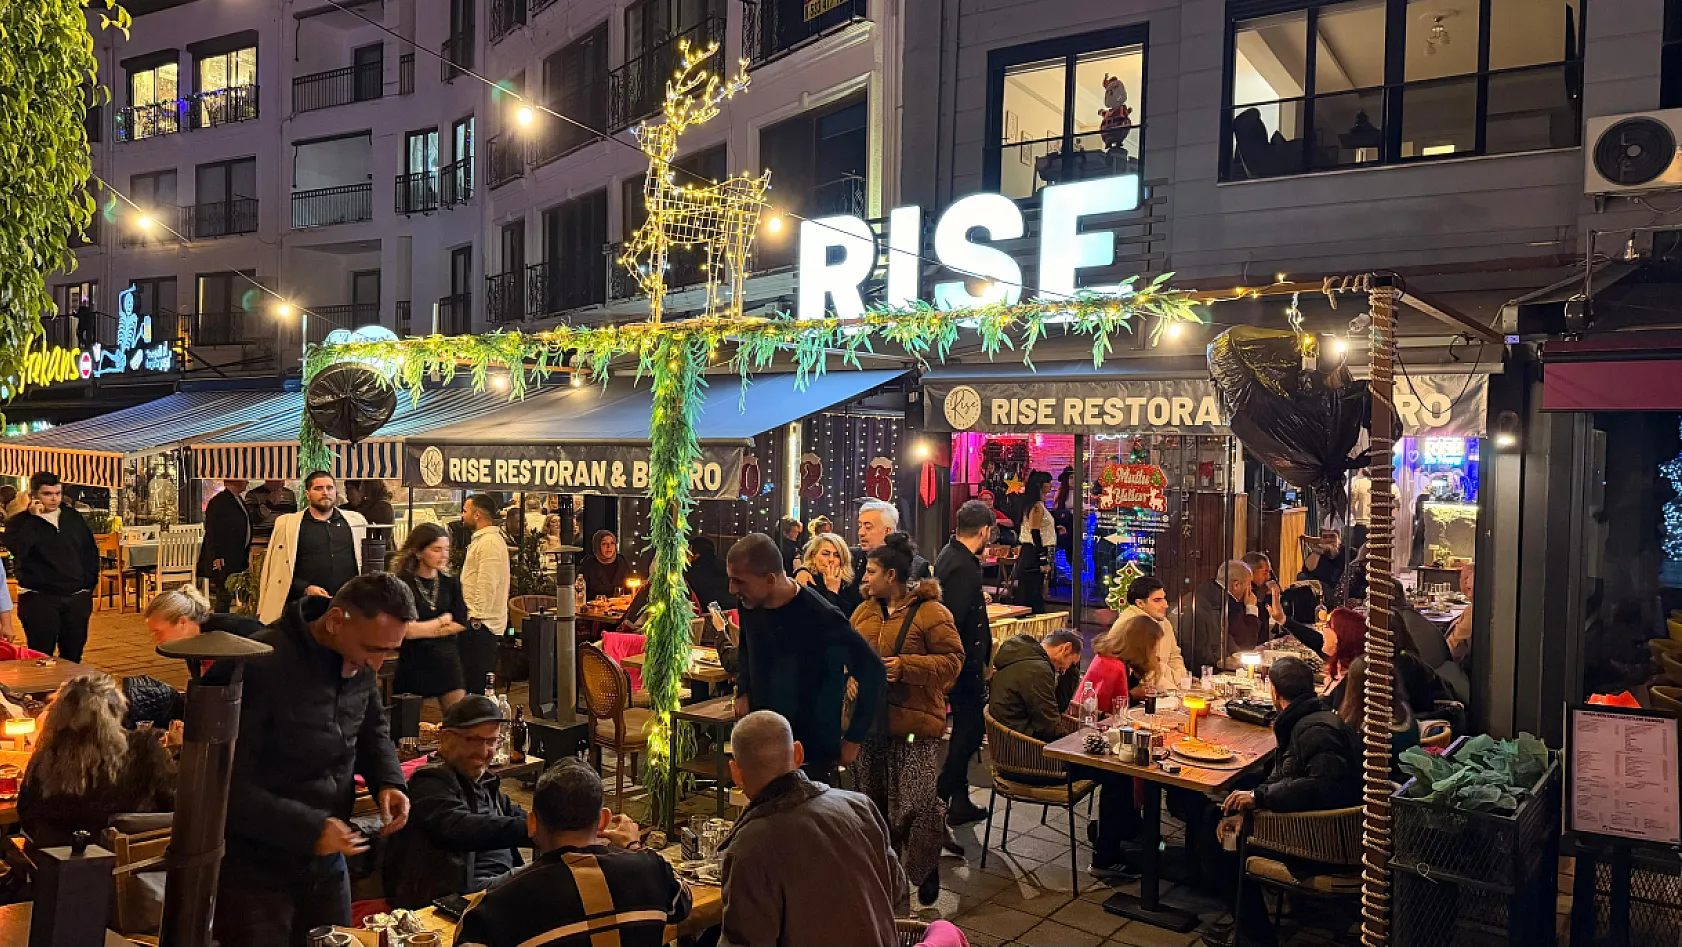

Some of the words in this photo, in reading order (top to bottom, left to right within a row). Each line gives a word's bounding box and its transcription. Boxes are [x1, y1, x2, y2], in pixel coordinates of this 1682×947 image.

[797, 174, 1139, 330] RISE
[991, 398, 1056, 425] RISE
[1063, 396, 1226, 426] RESTORA
[449, 457, 491, 483] RISE
[495, 459, 606, 487] RESTORAN
[610, 460, 627, 488] &
[632, 460, 722, 491] BRO
[1115, 466, 1150, 485] Mutlu
